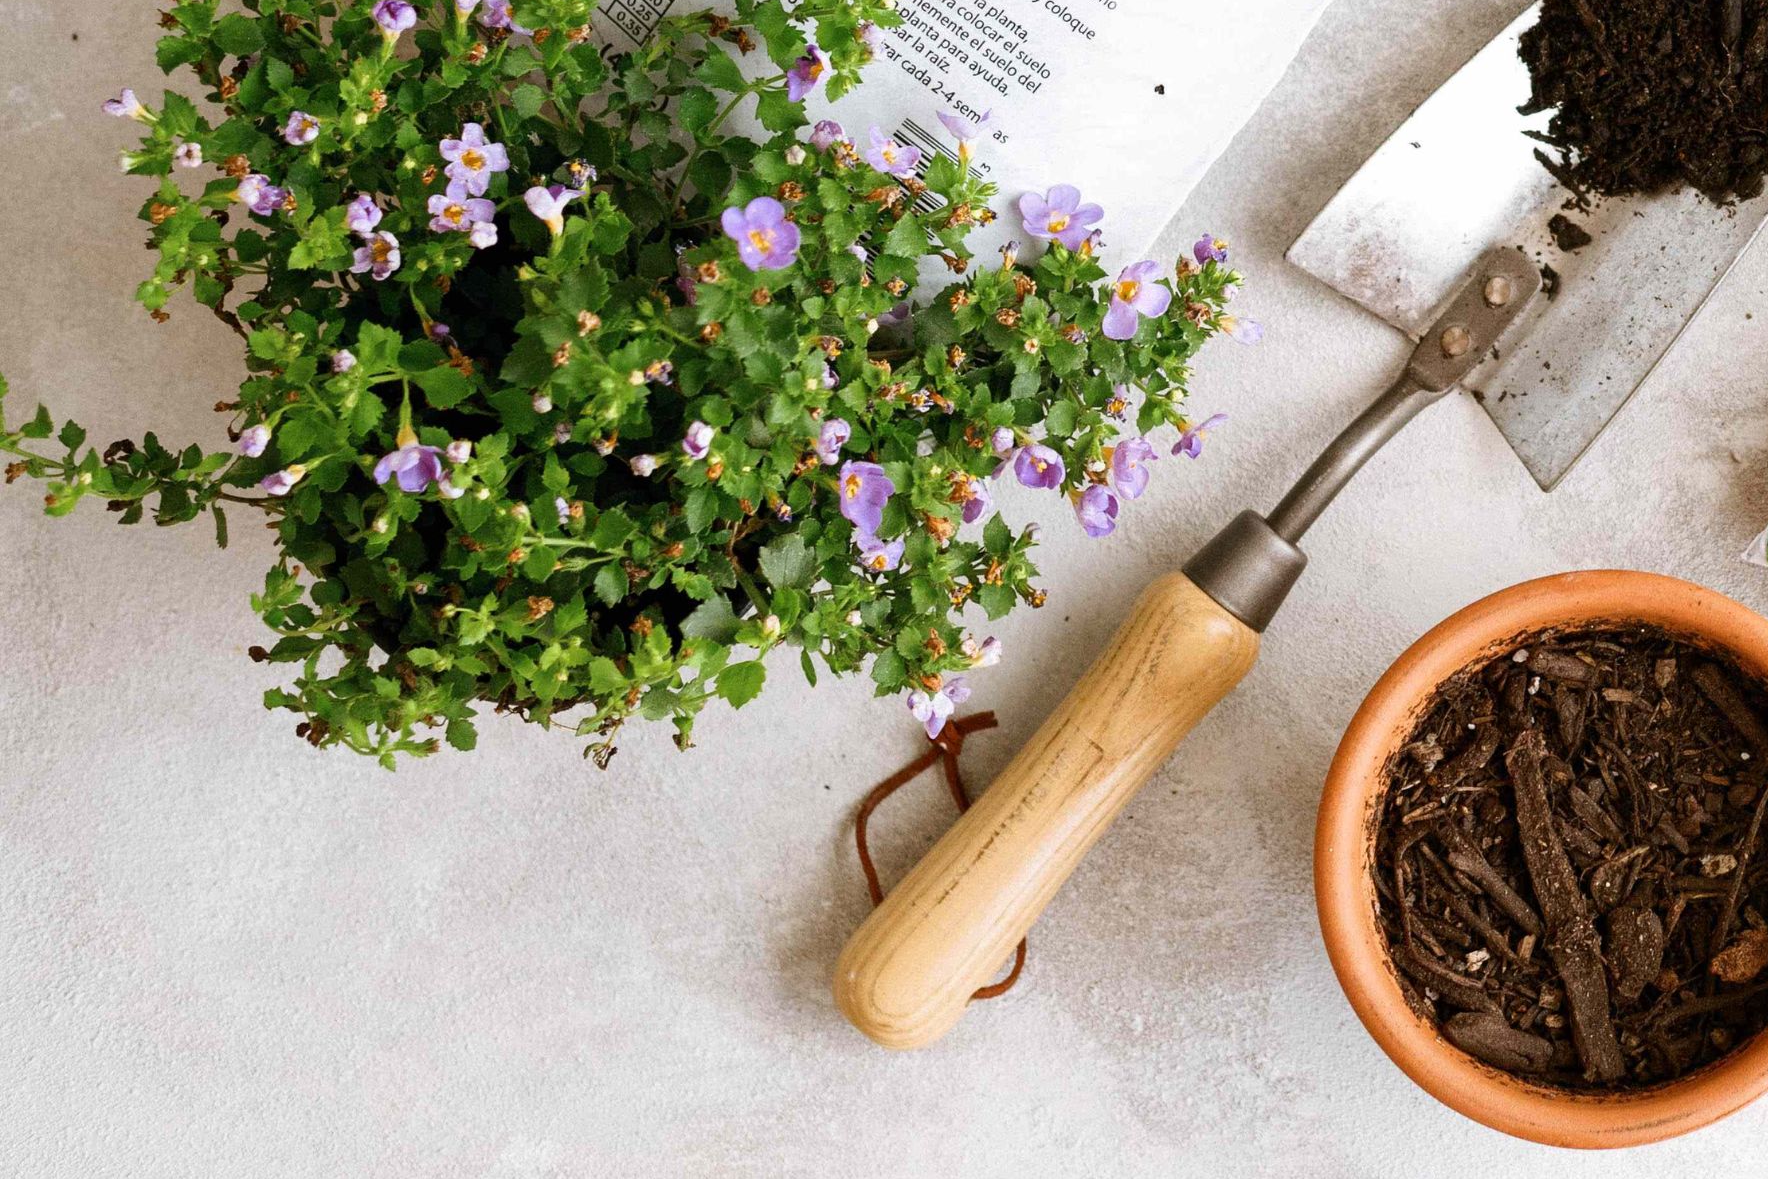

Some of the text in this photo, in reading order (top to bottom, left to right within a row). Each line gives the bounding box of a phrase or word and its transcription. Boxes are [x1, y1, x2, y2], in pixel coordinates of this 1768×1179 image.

[616, 11, 642, 36] 0.35
[956, 6, 1004, 43] colocar
[1002, 40, 1019, 54] el
[1015, 50, 1051, 79] suelo
